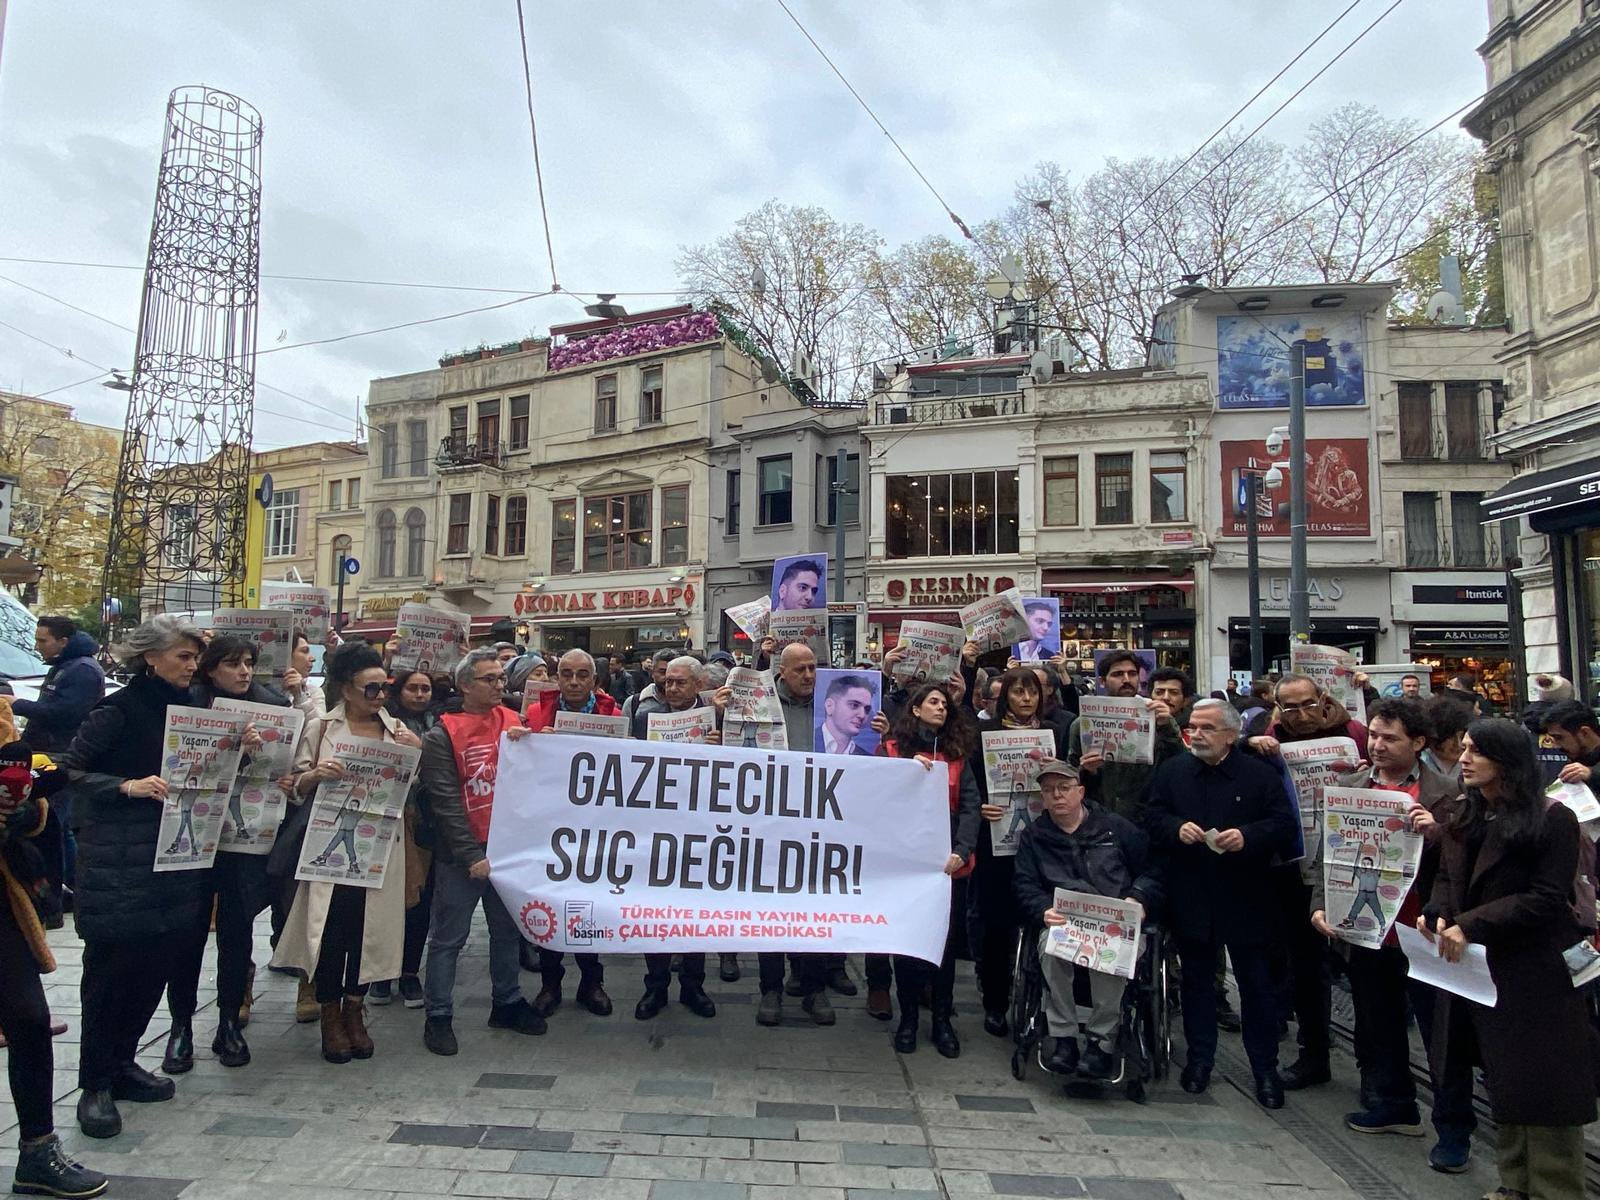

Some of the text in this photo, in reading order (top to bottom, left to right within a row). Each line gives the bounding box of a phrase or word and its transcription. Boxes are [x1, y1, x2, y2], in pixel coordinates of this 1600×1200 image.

[1234, 523, 1274, 532] RHHM
[910, 572, 990, 594] KESKİN
[523, 587, 683, 614] KONAK KEBAP
[1444, 631, 1467, 640] A&A
[170, 714, 193, 726] yeni
[557, 719, 578, 730] yeni
[650, 718, 670, 729] yeni
[1092, 718, 1124, 731] Yaşam'a
[181, 735, 217, 750] Yaşam'a
[1089, 729, 1127, 743] sahip çık
[335, 741, 361, 754] yeni
[1283, 747, 1300, 760] eni
[176, 748, 218, 767] sahip çık
[998, 750, 1029, 763] Yaşam'a
[345, 761, 381, 776] Yaşam'a
[568, 750, 845, 821] GAZETECİLİK
[1327, 794, 1402, 811] yeni yaşam
[1342, 814, 1385, 830] Yaşam'a
[1339, 828, 1390, 848] sahip çık
[546, 823, 863, 896] SUÇ DEĞİLDİR!
[1056, 898, 1081, 910] yeni
[527, 915, 549, 928] DİSK
[620, 904, 889, 926] TÜRKİYE BASIN YAYIN MATBAA
[1069, 916, 1105, 932] Yaşam'a
[618, 921, 833, 943] ÇALIŞANLARI SENDİKASI
[1063, 927, 1109, 949] sahip çık
